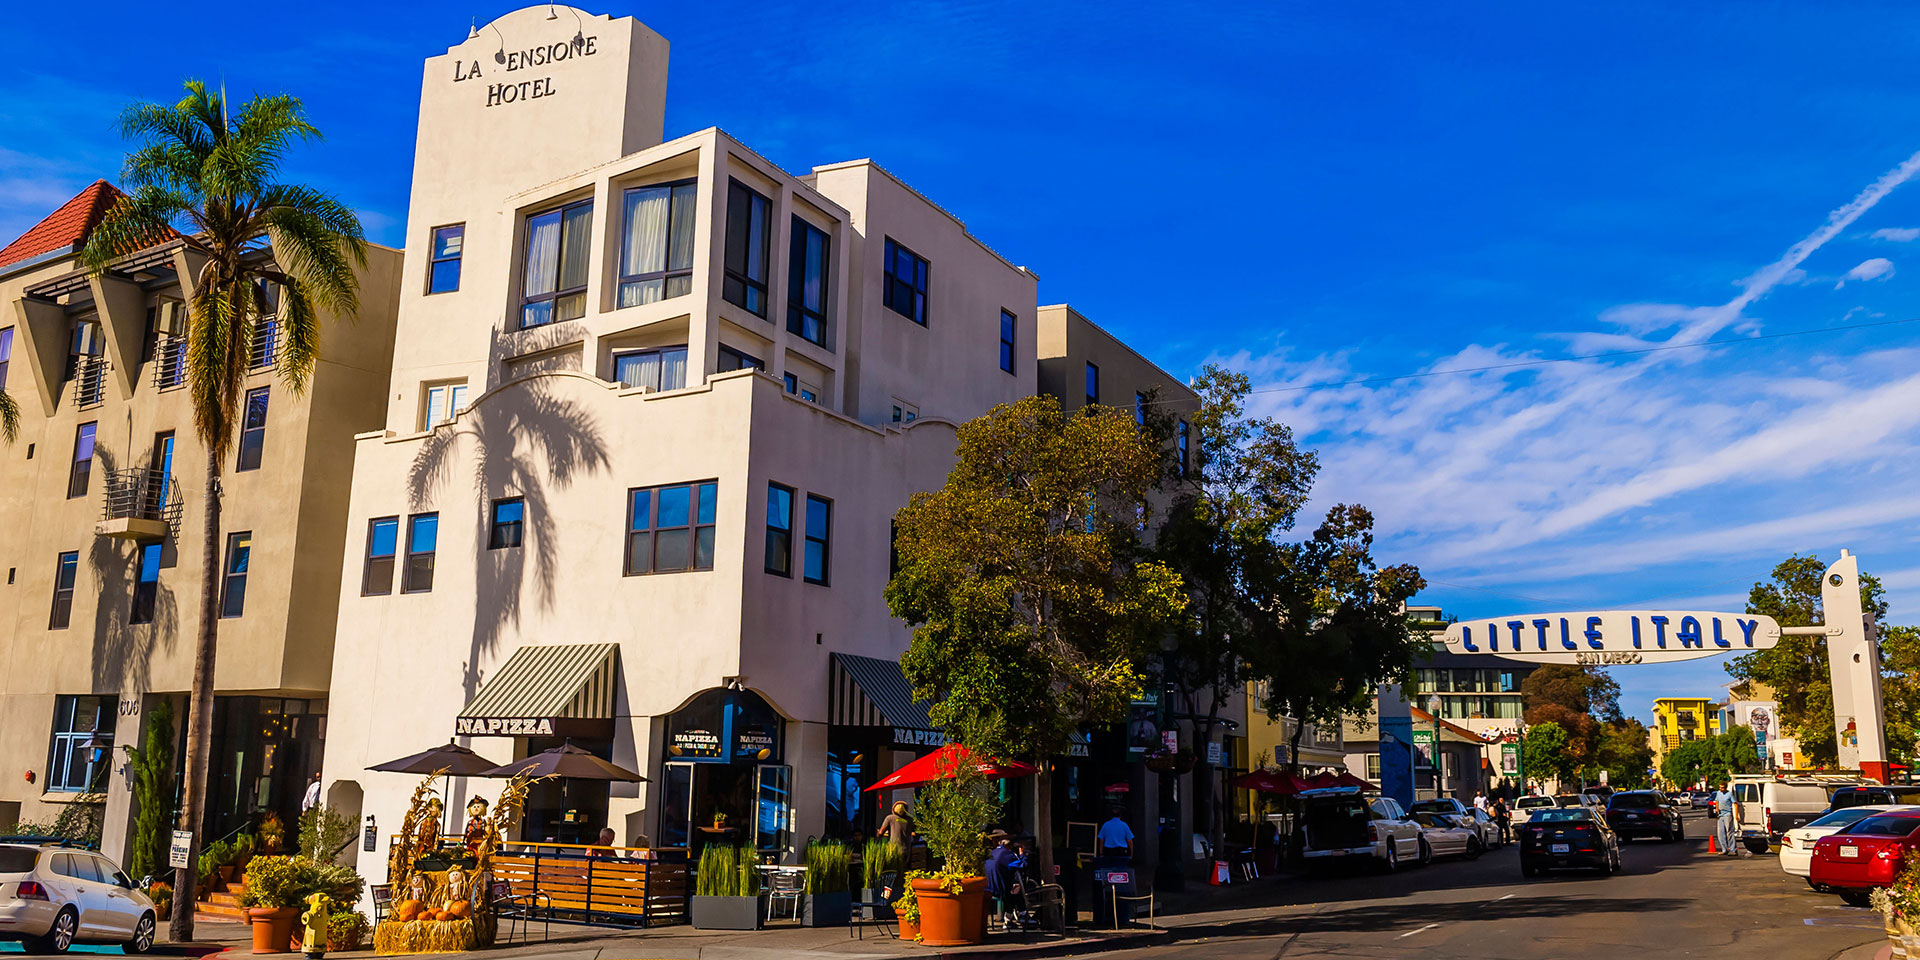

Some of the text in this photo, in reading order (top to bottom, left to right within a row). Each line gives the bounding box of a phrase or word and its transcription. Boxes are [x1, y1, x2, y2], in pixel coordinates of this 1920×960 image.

[453, 60, 482, 82] LA
[486, 77, 556, 107] HOTEL
[1463, 615, 1758, 652] LITTLE ITALY
[1575, 652, 1643, 664] SAN DIEGO
[120, 700, 139, 716] 606
[457, 718, 553, 735] NAPIZZA
[675, 734, 718, 743] NAPIZZA
[740, 735, 773, 744] NAPIZZA
